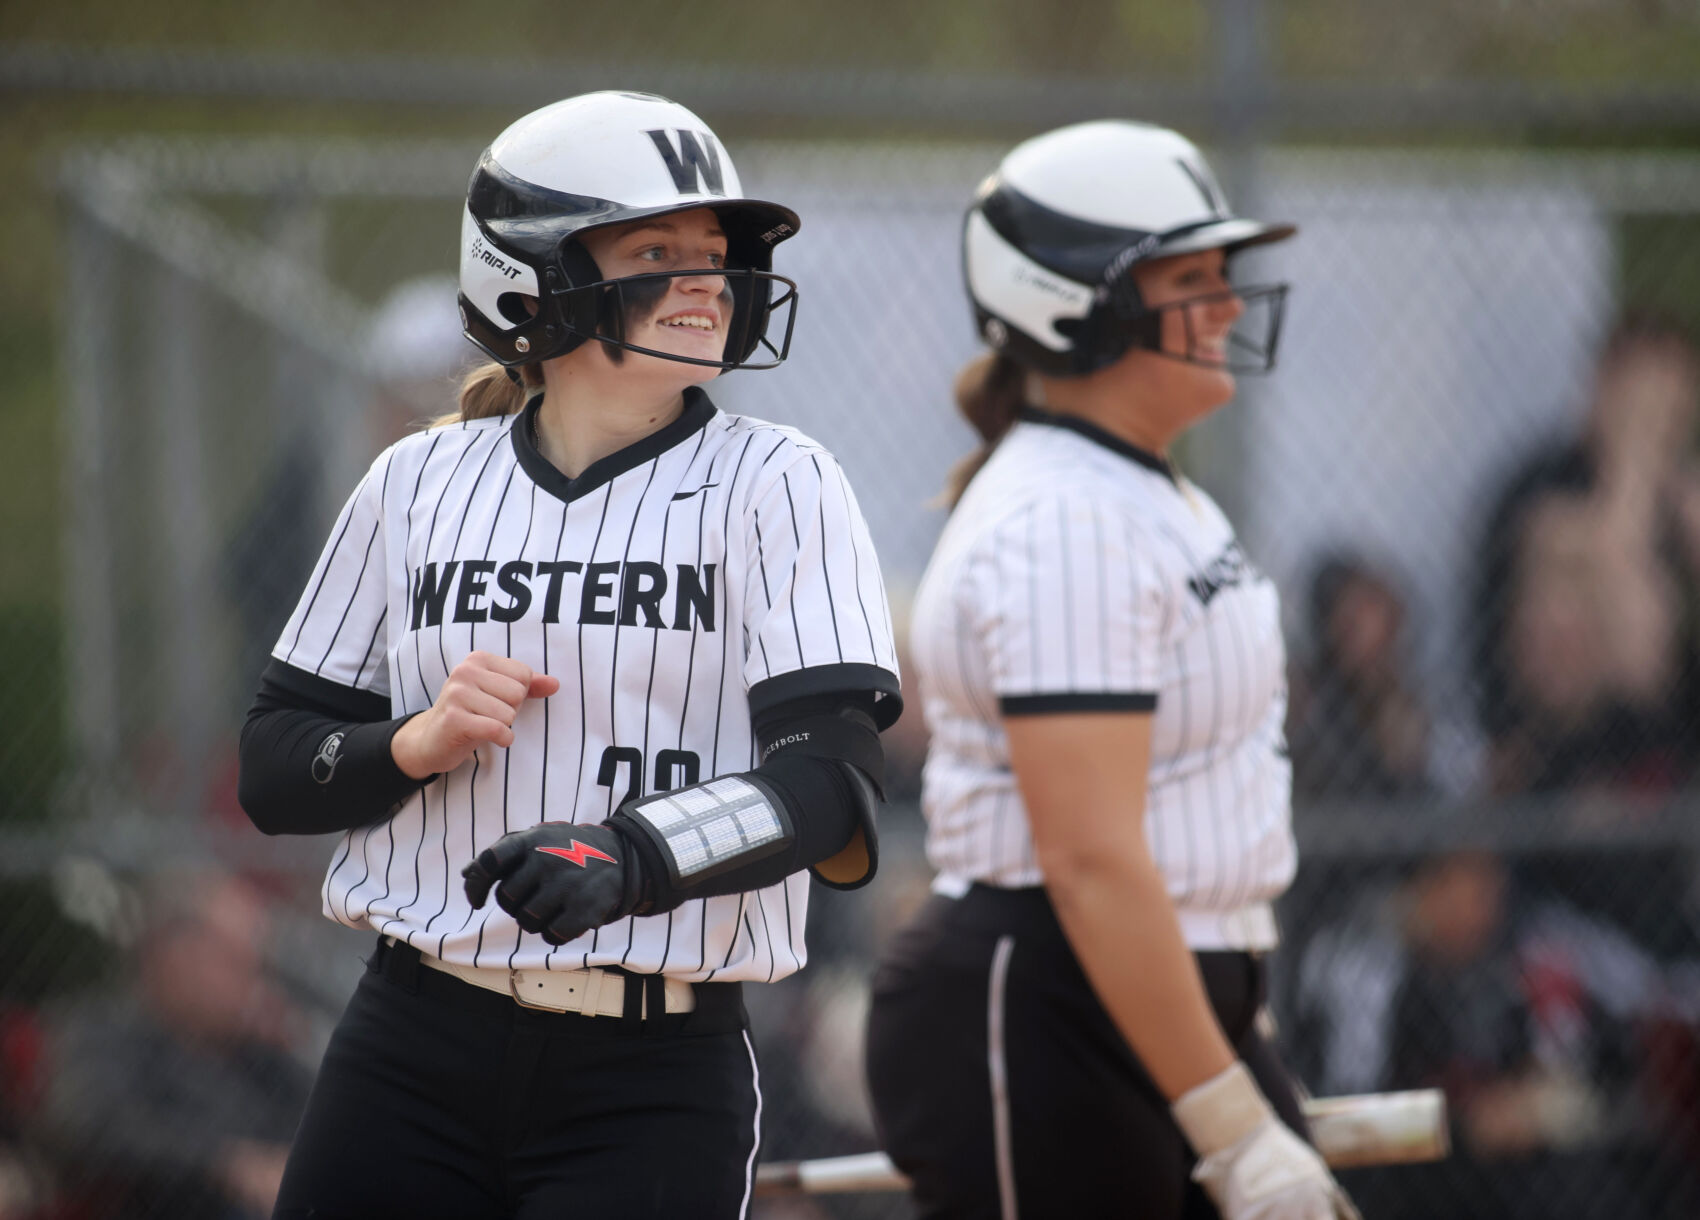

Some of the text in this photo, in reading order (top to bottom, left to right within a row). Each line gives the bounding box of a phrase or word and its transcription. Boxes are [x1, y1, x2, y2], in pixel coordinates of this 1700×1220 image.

[641, 129, 726, 196] W
[480, 249, 522, 279] RIP-IT
[410, 560, 717, 632] WESTERN
